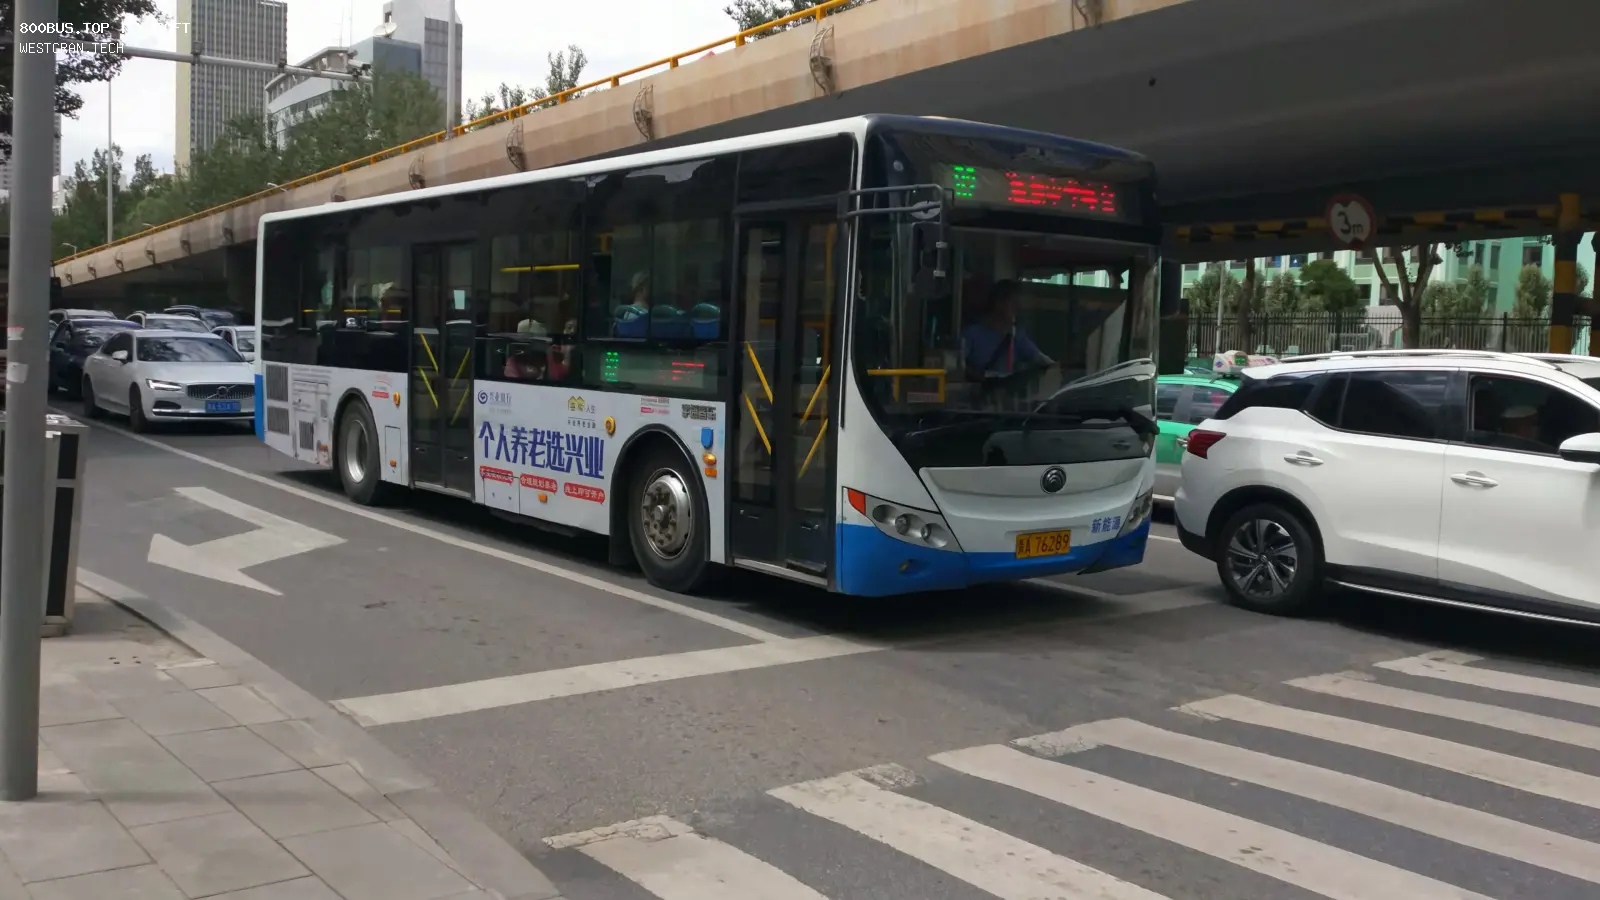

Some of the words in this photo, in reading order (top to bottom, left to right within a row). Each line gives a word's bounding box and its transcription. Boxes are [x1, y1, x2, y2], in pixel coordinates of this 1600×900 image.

[1337, 210, 1364, 236] 3m
[478, 421, 605, 480] 个人养老选兴业
[1091, 516, 1121, 534] 新能源
